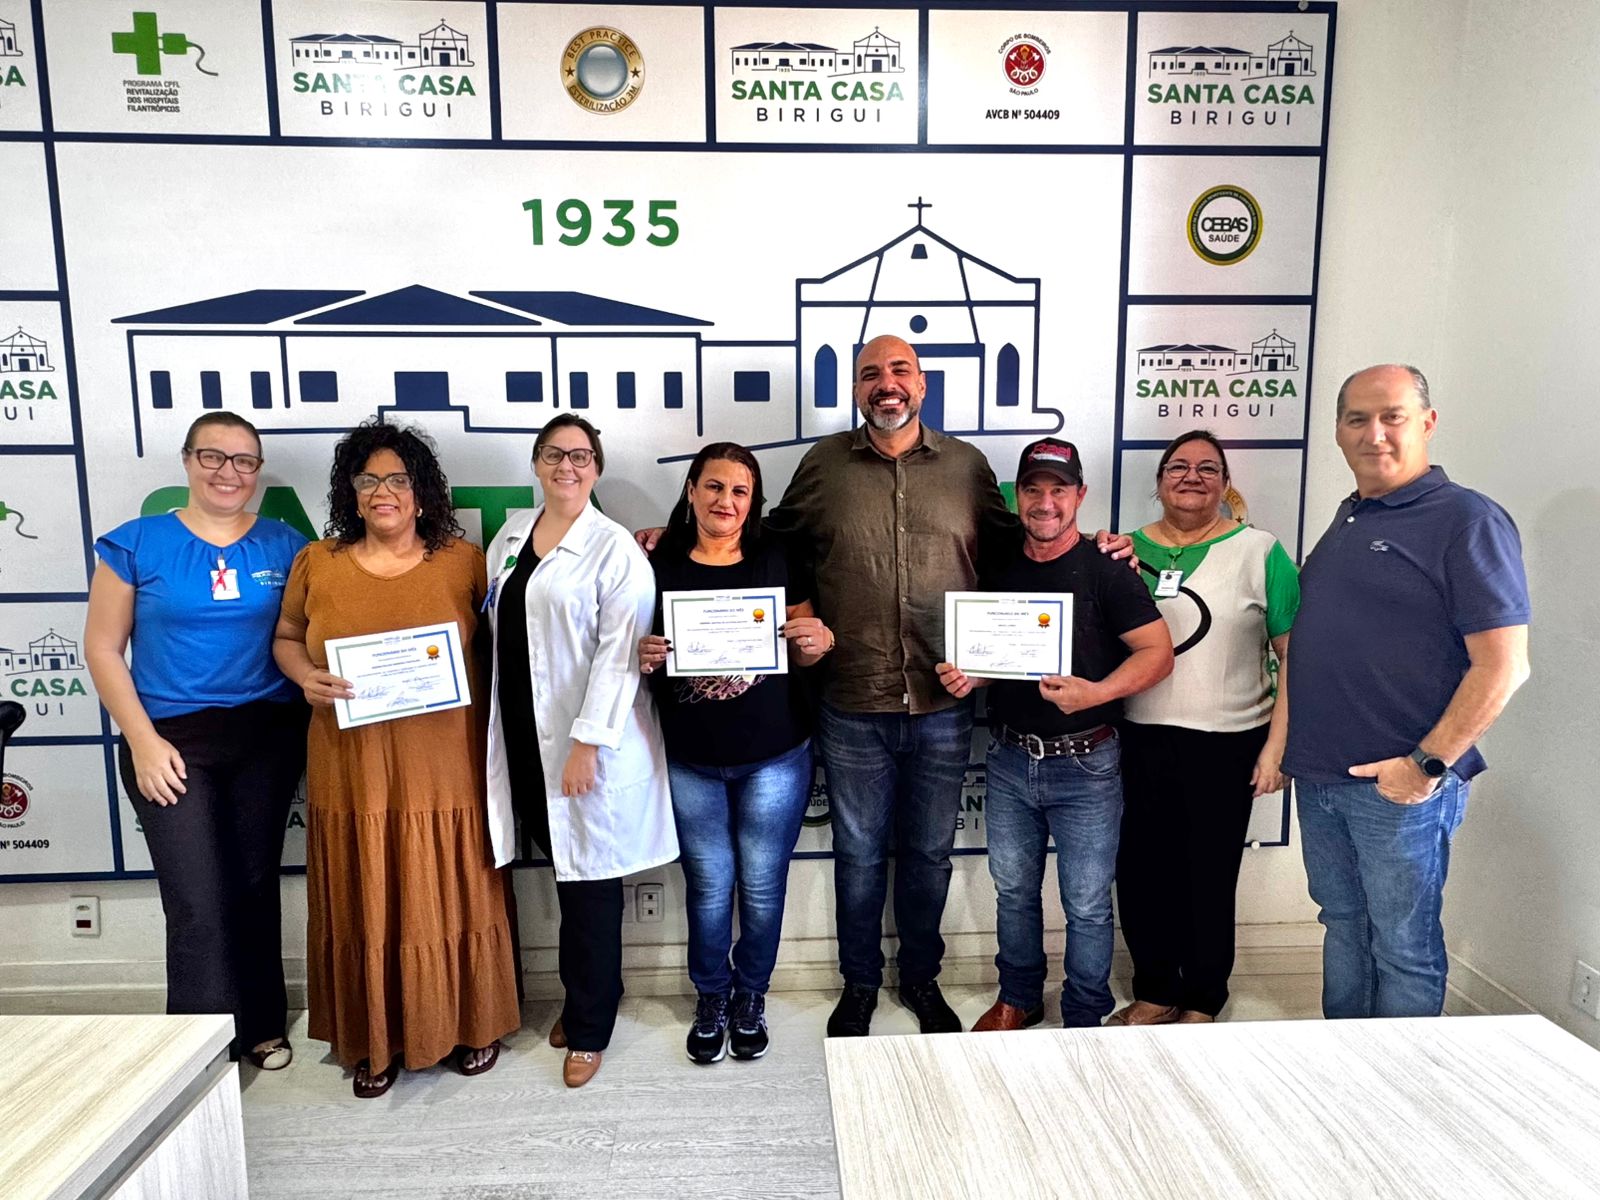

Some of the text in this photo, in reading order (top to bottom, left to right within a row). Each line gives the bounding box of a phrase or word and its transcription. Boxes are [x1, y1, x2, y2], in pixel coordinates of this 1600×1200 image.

[567, 30, 636, 59] BEST PRACTICE
[998, 36, 1014, 54] CORPO
[1023, 33, 1051, 54] BOMBEIROS
[126, 87, 178, 97] REVITALIZAÇÃO
[398, 74, 476, 96] CASA
[731, 80, 904, 101] SANTA CASA
[1009, 87, 1039, 96] SÃO PAULO
[569, 85, 639, 112] ESTERILIZAÇÃO 3M
[1147, 83, 1315, 105] SANTA CASA
[127, 104, 180, 112] FILANTRÓPICOS
[320, 101, 452, 117] BIRIGUI
[756, 107, 880, 122] BIRIGUI
[985, 109, 1009, 119] AVCB
[1024, 109, 1060, 120] 504409
[1170, 110, 1291, 126] BIRIGUI
[522, 199, 679, 247] 1935
[1201, 217, 1248, 232] CEBAS
[1208, 232, 1239, 242] SAÚDE
[0, 380, 57, 400] ASA
[1136, 379, 1297, 398] SANTA CASA
[1158, 404, 1274, 417] BIRIGUI
[10, 678, 87, 697] CASA
[12, 839, 50, 850] 504409
